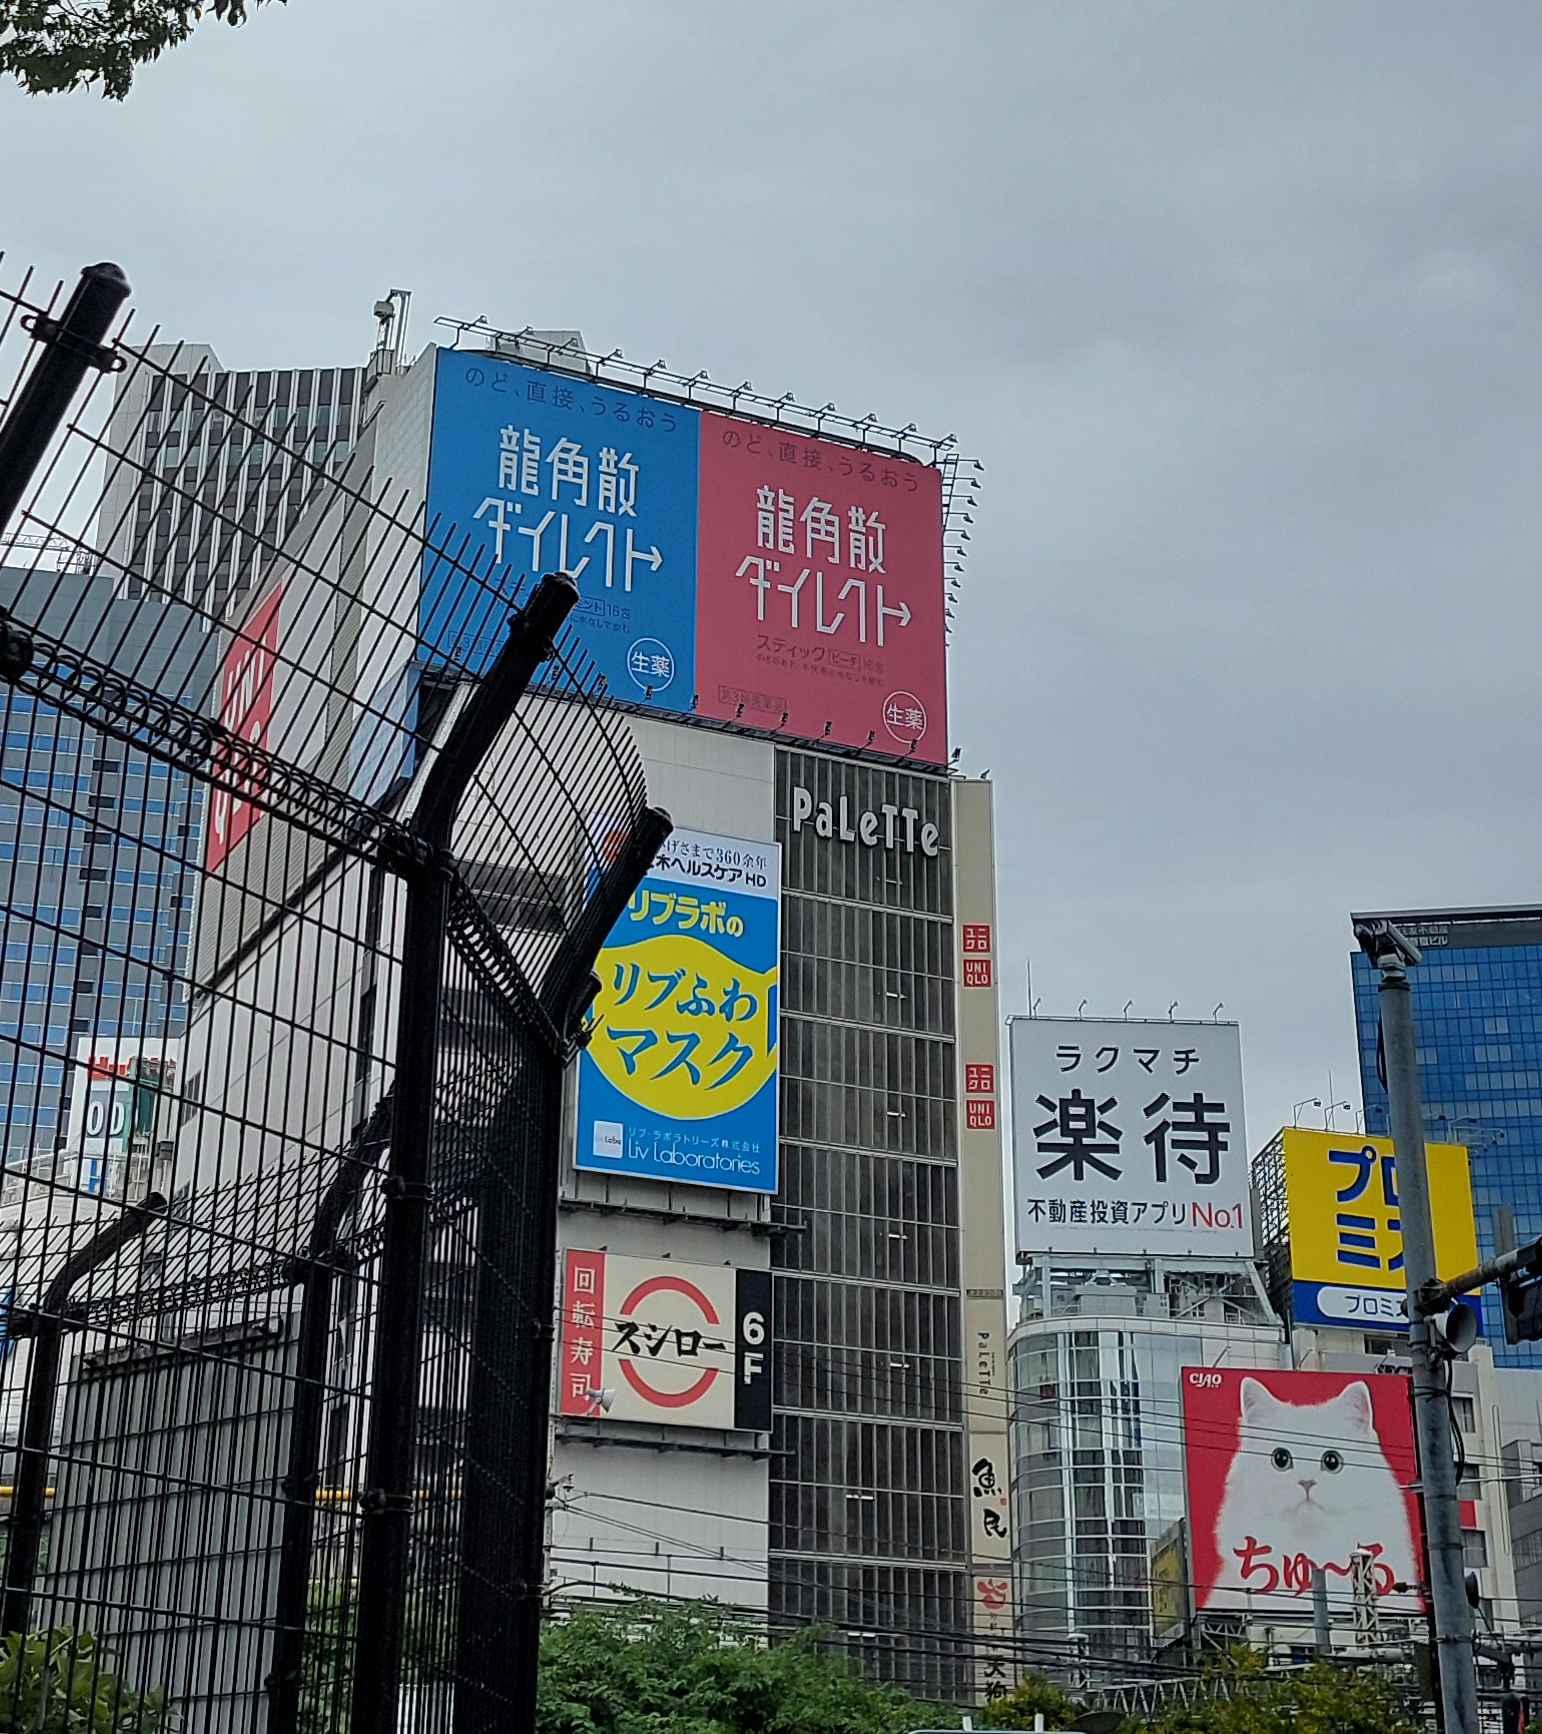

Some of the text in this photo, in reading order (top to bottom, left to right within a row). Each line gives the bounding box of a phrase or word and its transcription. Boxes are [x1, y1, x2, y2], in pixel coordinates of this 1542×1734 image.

[498, 424, 639, 517] 龍角散
[472, 497, 664, 592] ダイレクト
[755, 484, 887, 574] 龍角散
[735, 555, 912, 647] ダイレクト
[627, 888, 745, 937] リブラボの
[612, 960, 759, 1023] リブふわ
[605, 1023, 756, 1091] マスク
[1056, 1045, 1201, 1075] ラクマチ
[628, 1138, 761, 1175] Liv Laboratories
[1032, 1088, 1232, 1185] 楽待
[569, 1264, 599, 1404] 回転寿司
[611, 1319, 727, 1358] スシロー
[972, 1457, 1008, 1540] 魚民
